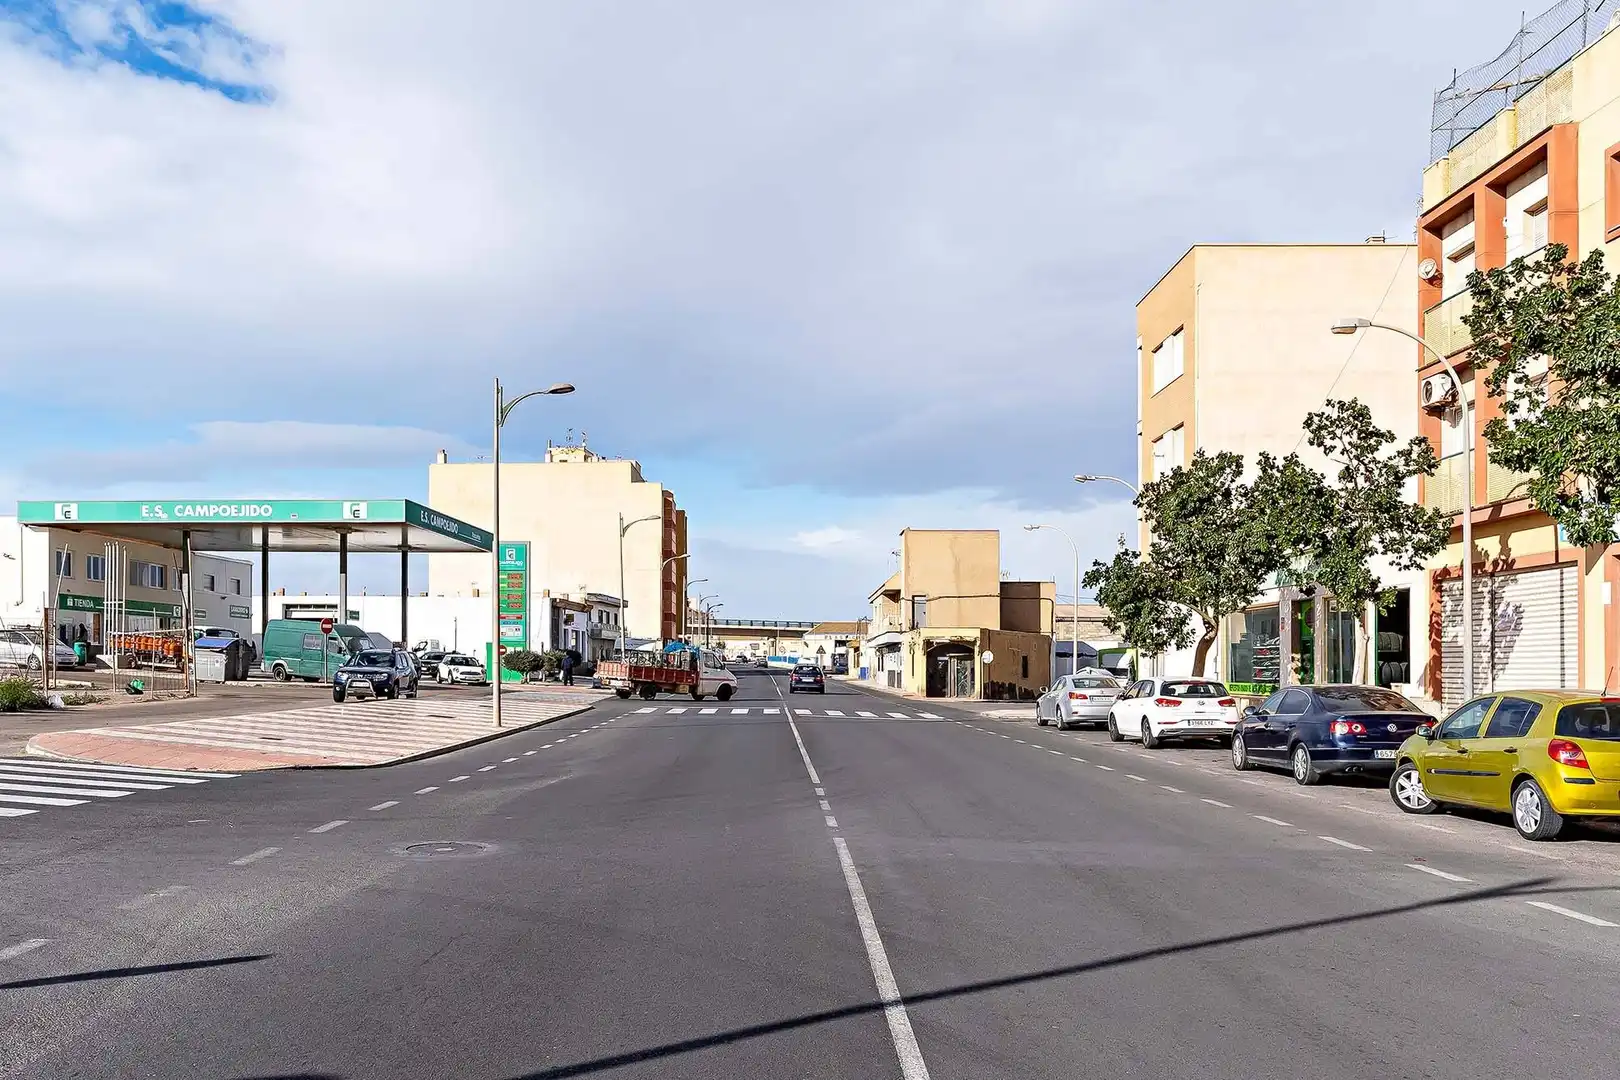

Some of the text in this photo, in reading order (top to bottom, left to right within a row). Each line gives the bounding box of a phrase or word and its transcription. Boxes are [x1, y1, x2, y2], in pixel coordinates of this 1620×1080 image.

[174, 504, 273, 518] CAMPOEJIDO
[430, 514, 459, 534] CAMPOEJIDO
[74, 598, 95, 608] TIENDA
